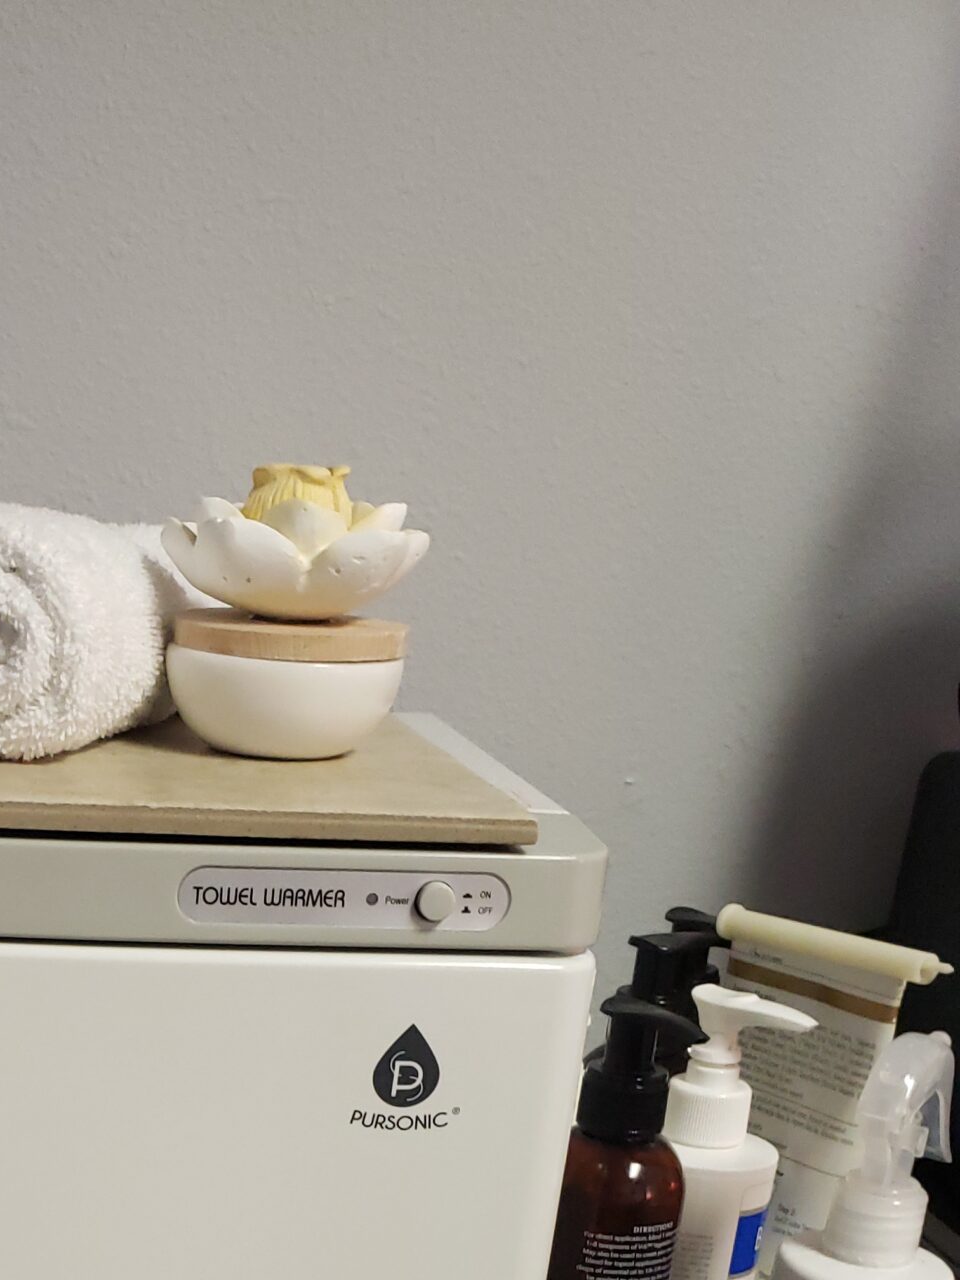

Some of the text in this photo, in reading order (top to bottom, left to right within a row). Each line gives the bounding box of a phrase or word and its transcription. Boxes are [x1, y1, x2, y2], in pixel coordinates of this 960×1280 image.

[193, 886, 346, 908] TOWEL WARMER
[480, 891, 492, 899] ON
[385, 896, 409, 904] Power
[478, 907, 492, 915] OFF
[349, 1109, 449, 1131] PURSONIC
